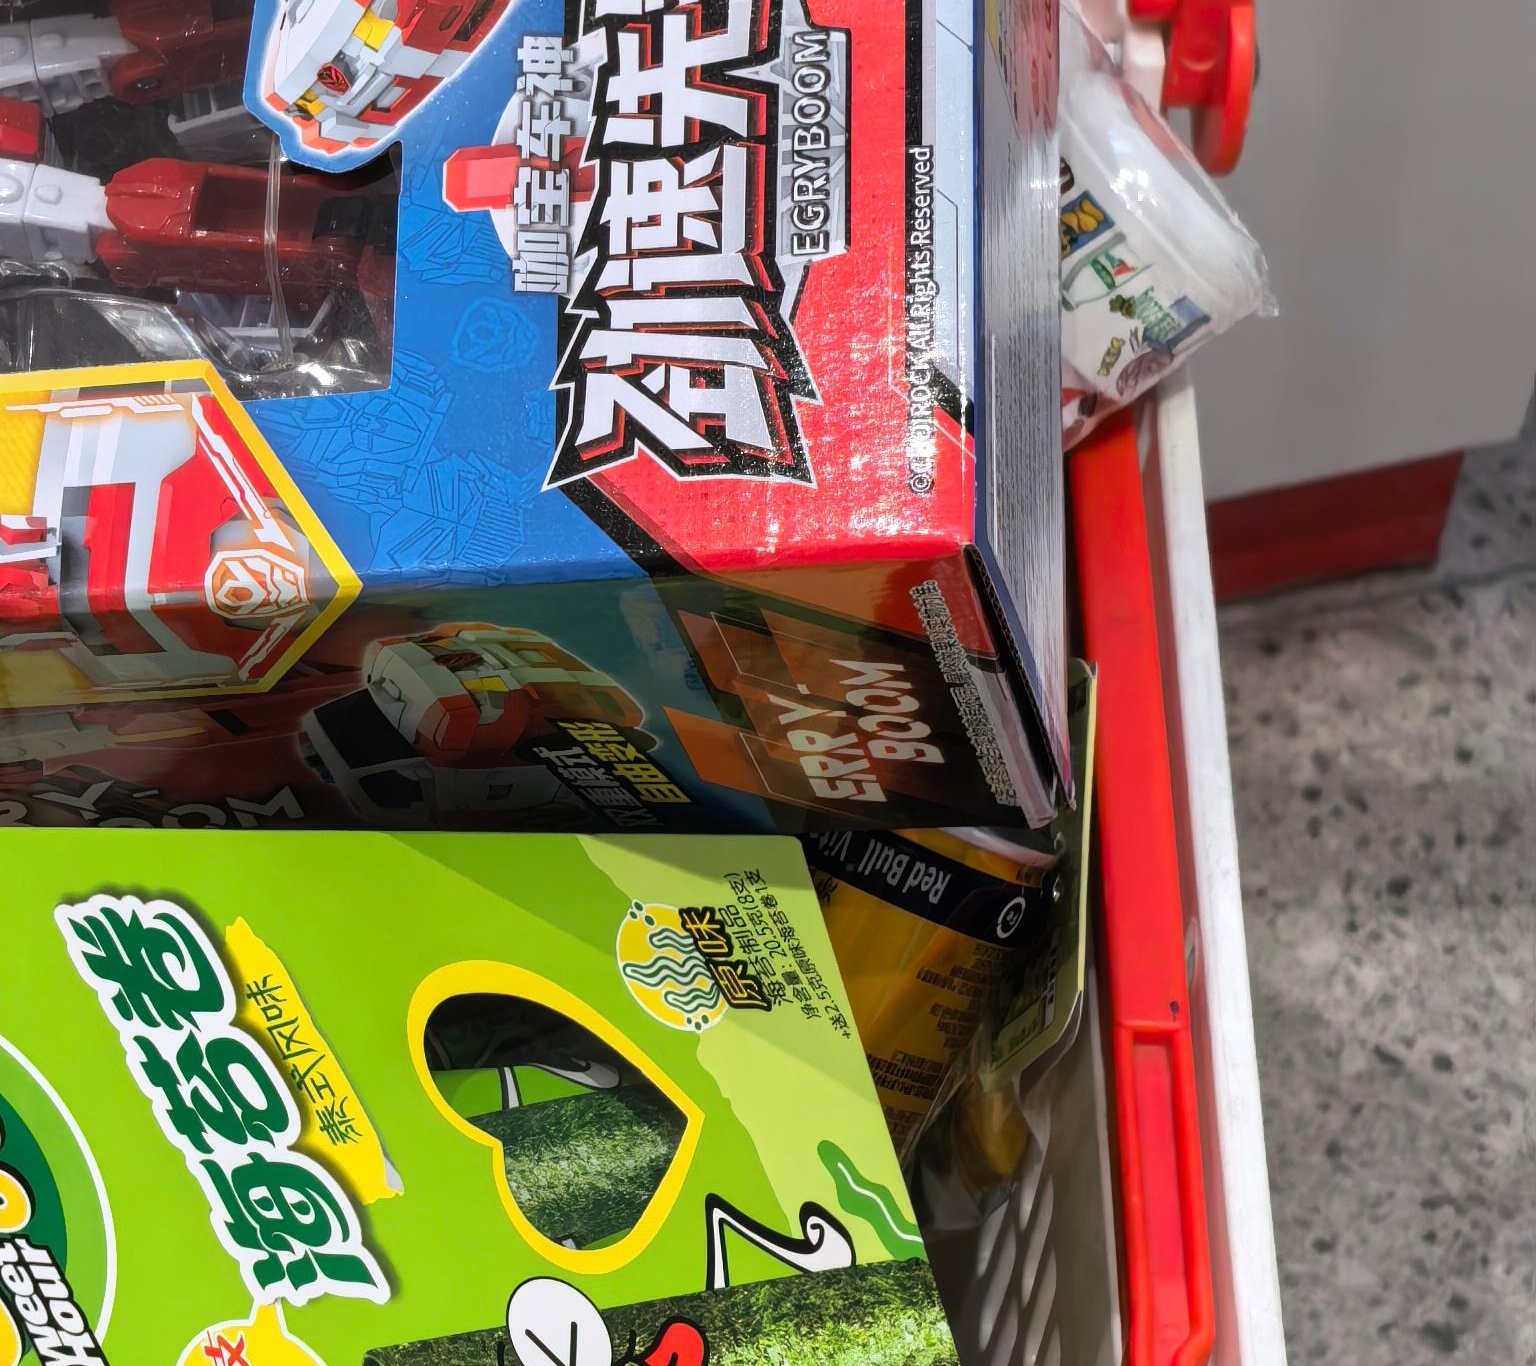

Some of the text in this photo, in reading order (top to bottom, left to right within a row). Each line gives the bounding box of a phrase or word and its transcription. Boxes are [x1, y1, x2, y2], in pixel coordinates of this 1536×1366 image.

[514, 35, 577, 296] 咖宝车神
[790, 28, 834, 258] EGRYBOOM
[909, 146, 934, 250] Reserved
[907, 251, 941, 316] Rights
[863, 841, 906, 889] Bull
[904, 862, 952, 905] Red
[679, 906, 773, 1012] 原味
[717, 903, 793, 1007] 海苔制品
[66, 902, 380, 1291] 海苔卷
[244, 971, 367, 1149] 泰式风味
